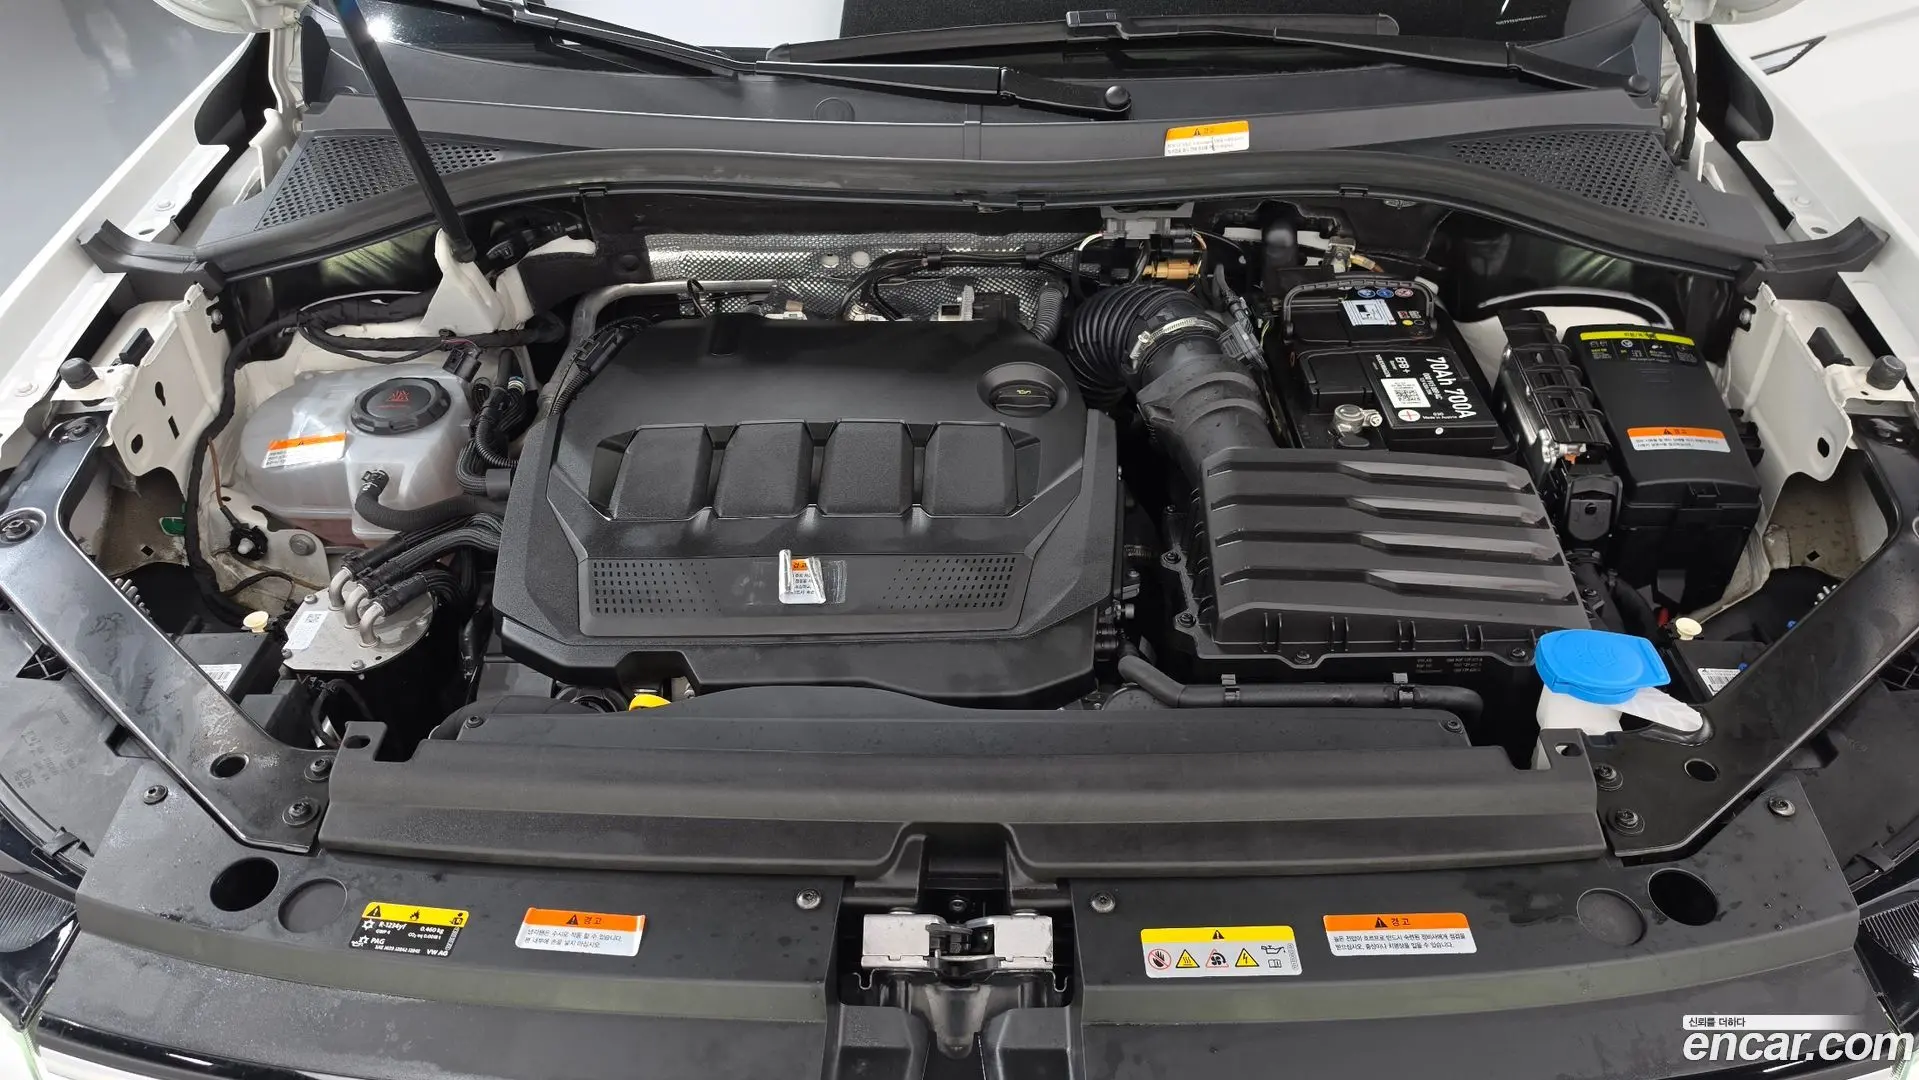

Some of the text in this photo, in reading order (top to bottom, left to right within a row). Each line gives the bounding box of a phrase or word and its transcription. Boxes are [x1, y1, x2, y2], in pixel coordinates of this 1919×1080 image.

[1426, 356, 1477, 419] 70Ah 700A
[370, 937, 386, 945] PAG
